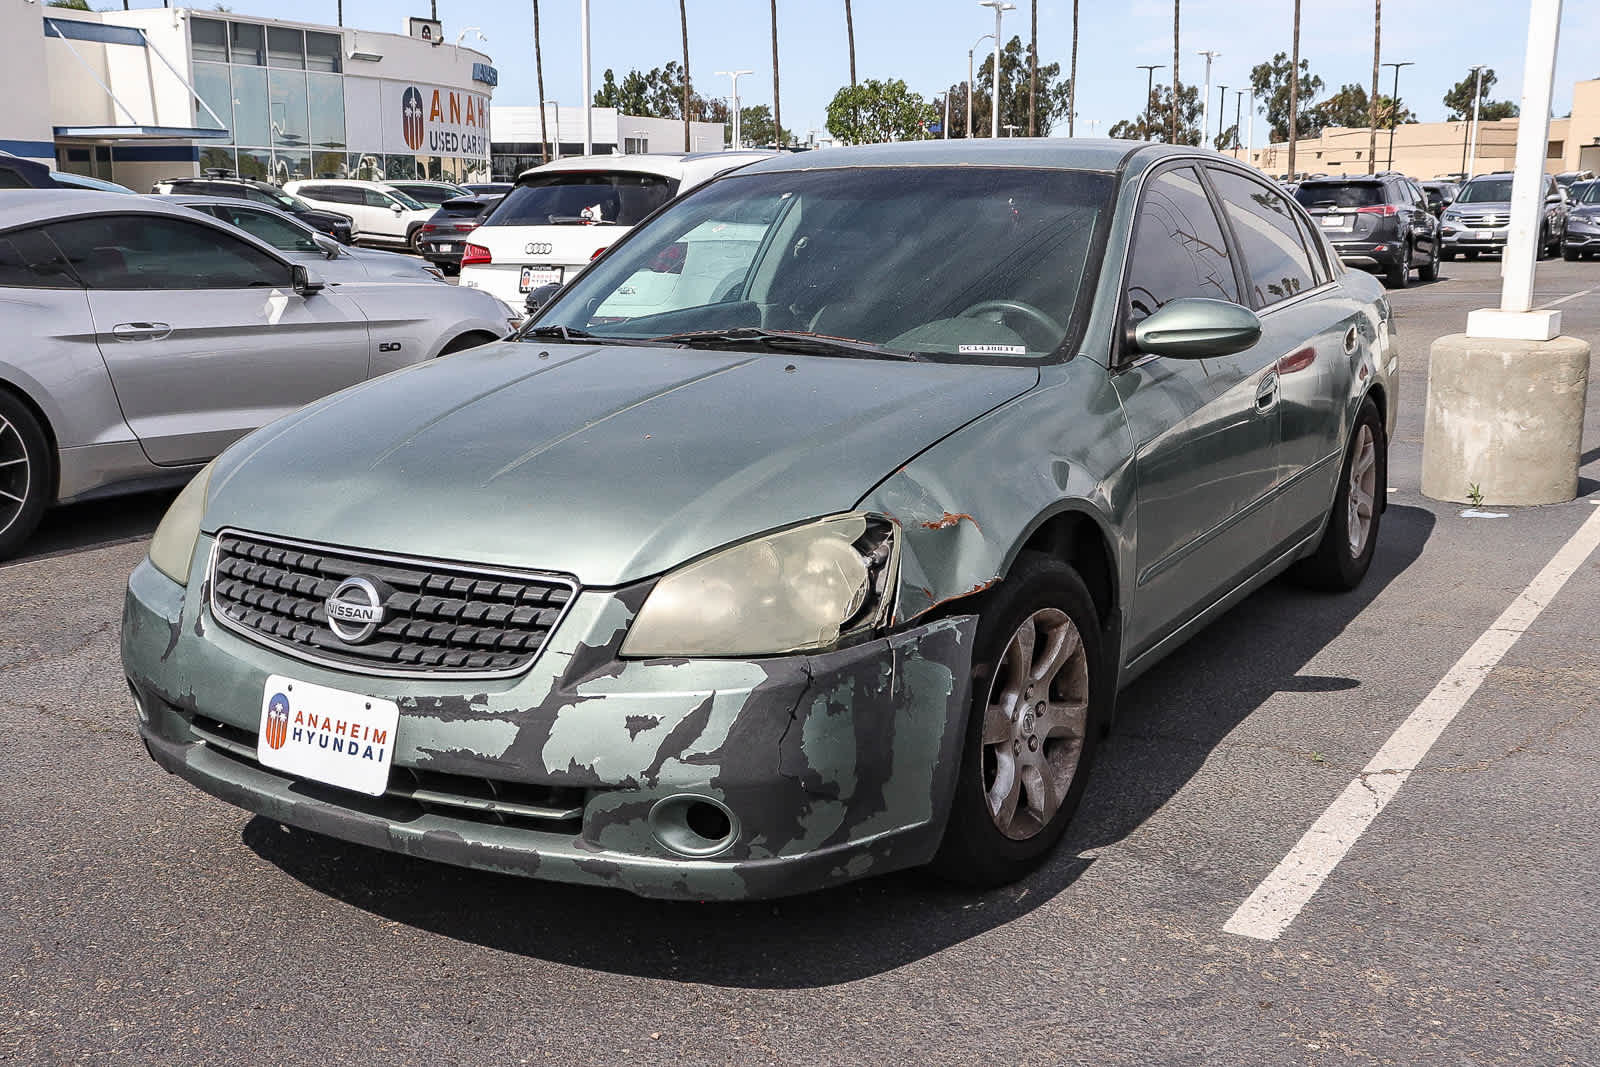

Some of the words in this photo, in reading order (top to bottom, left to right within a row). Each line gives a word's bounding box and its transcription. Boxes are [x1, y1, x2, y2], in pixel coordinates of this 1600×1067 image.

[430, 131, 459, 152] USED
[461, 133, 478, 155] CAR
[327, 603, 373, 619] NISSAN
[295, 710, 387, 745] ANAHEIM
[292, 727, 384, 762] HYUNDAI
